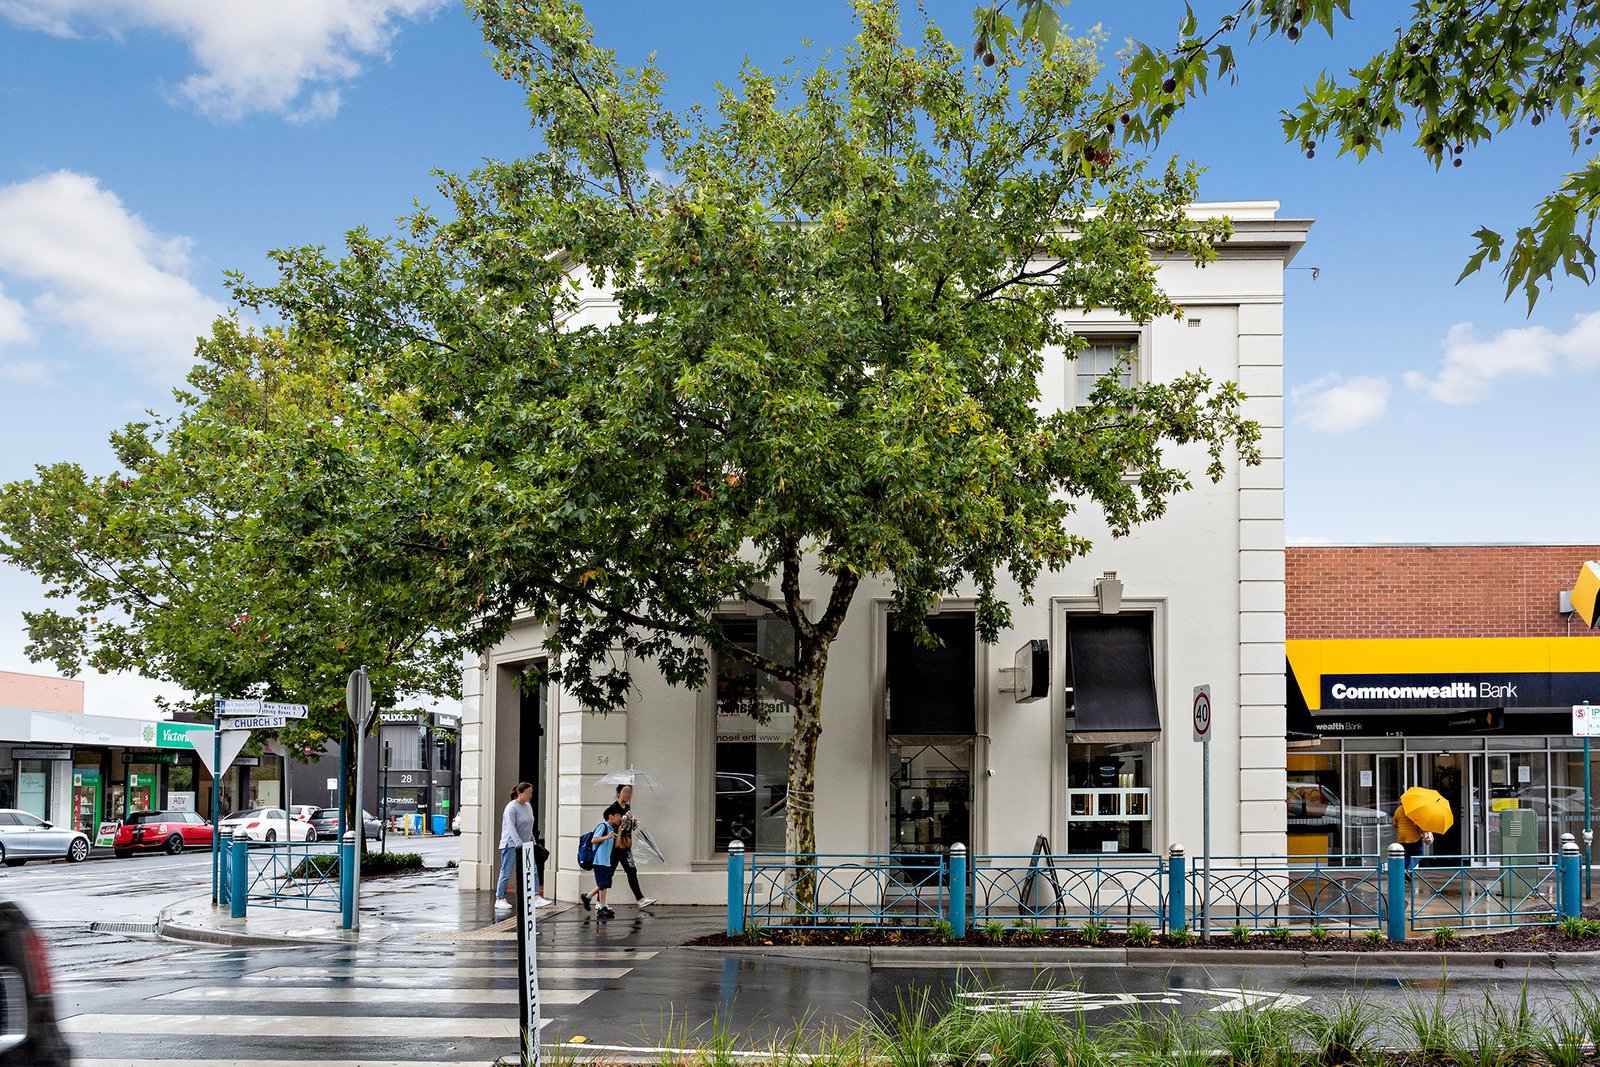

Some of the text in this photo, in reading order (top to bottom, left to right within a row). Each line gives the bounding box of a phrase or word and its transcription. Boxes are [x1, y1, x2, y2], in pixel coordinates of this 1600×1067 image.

[1331, 682, 1518, 699] Commonwealth Bank
[1196, 704, 1208, 722] 40
[234, 717, 283, 728] CHURCH ST
[1345, 722, 1362, 730] Bank
[597, 755, 609, 764] 54
[401, 774, 412, 783] 28
[525, 848, 536, 1048] KEEP LEFT
